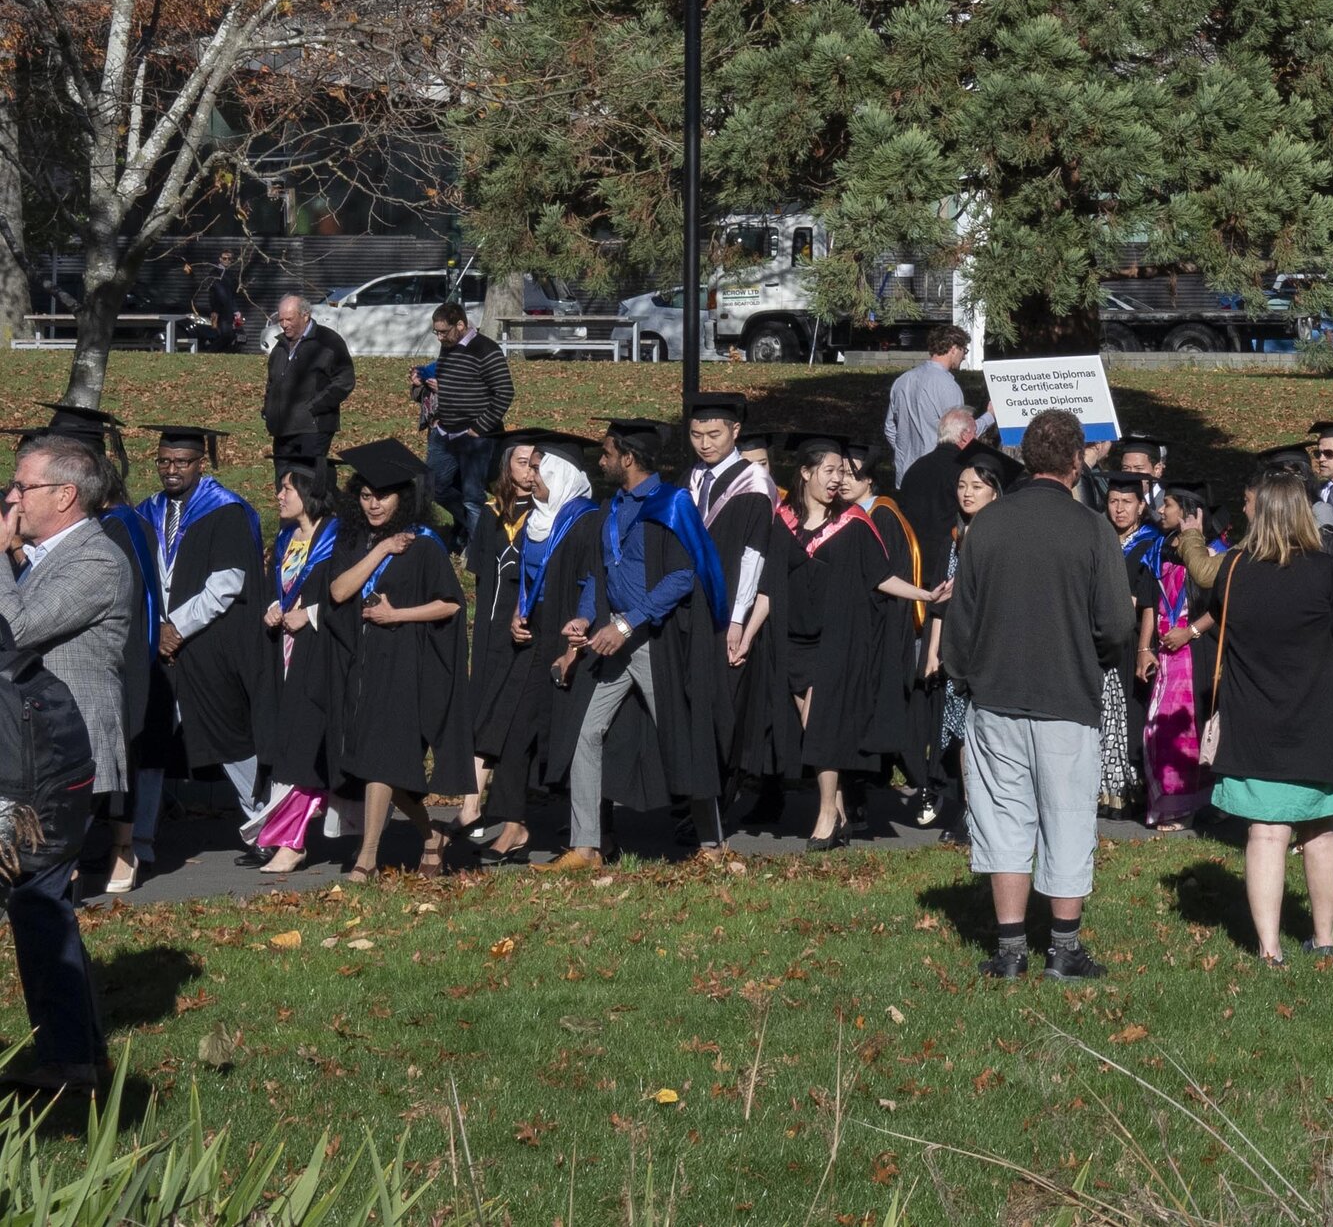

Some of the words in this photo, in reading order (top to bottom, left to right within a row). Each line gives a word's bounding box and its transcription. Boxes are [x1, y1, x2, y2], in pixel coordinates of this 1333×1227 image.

[990, 372, 1050, 383] Postgraduate
[1052, 370, 1096, 380] Diplomas
[1021, 382, 1074, 392] Certificates
[1006, 397, 1048, 406] Graduate
[1050, 395, 1094, 405] Diplomas
